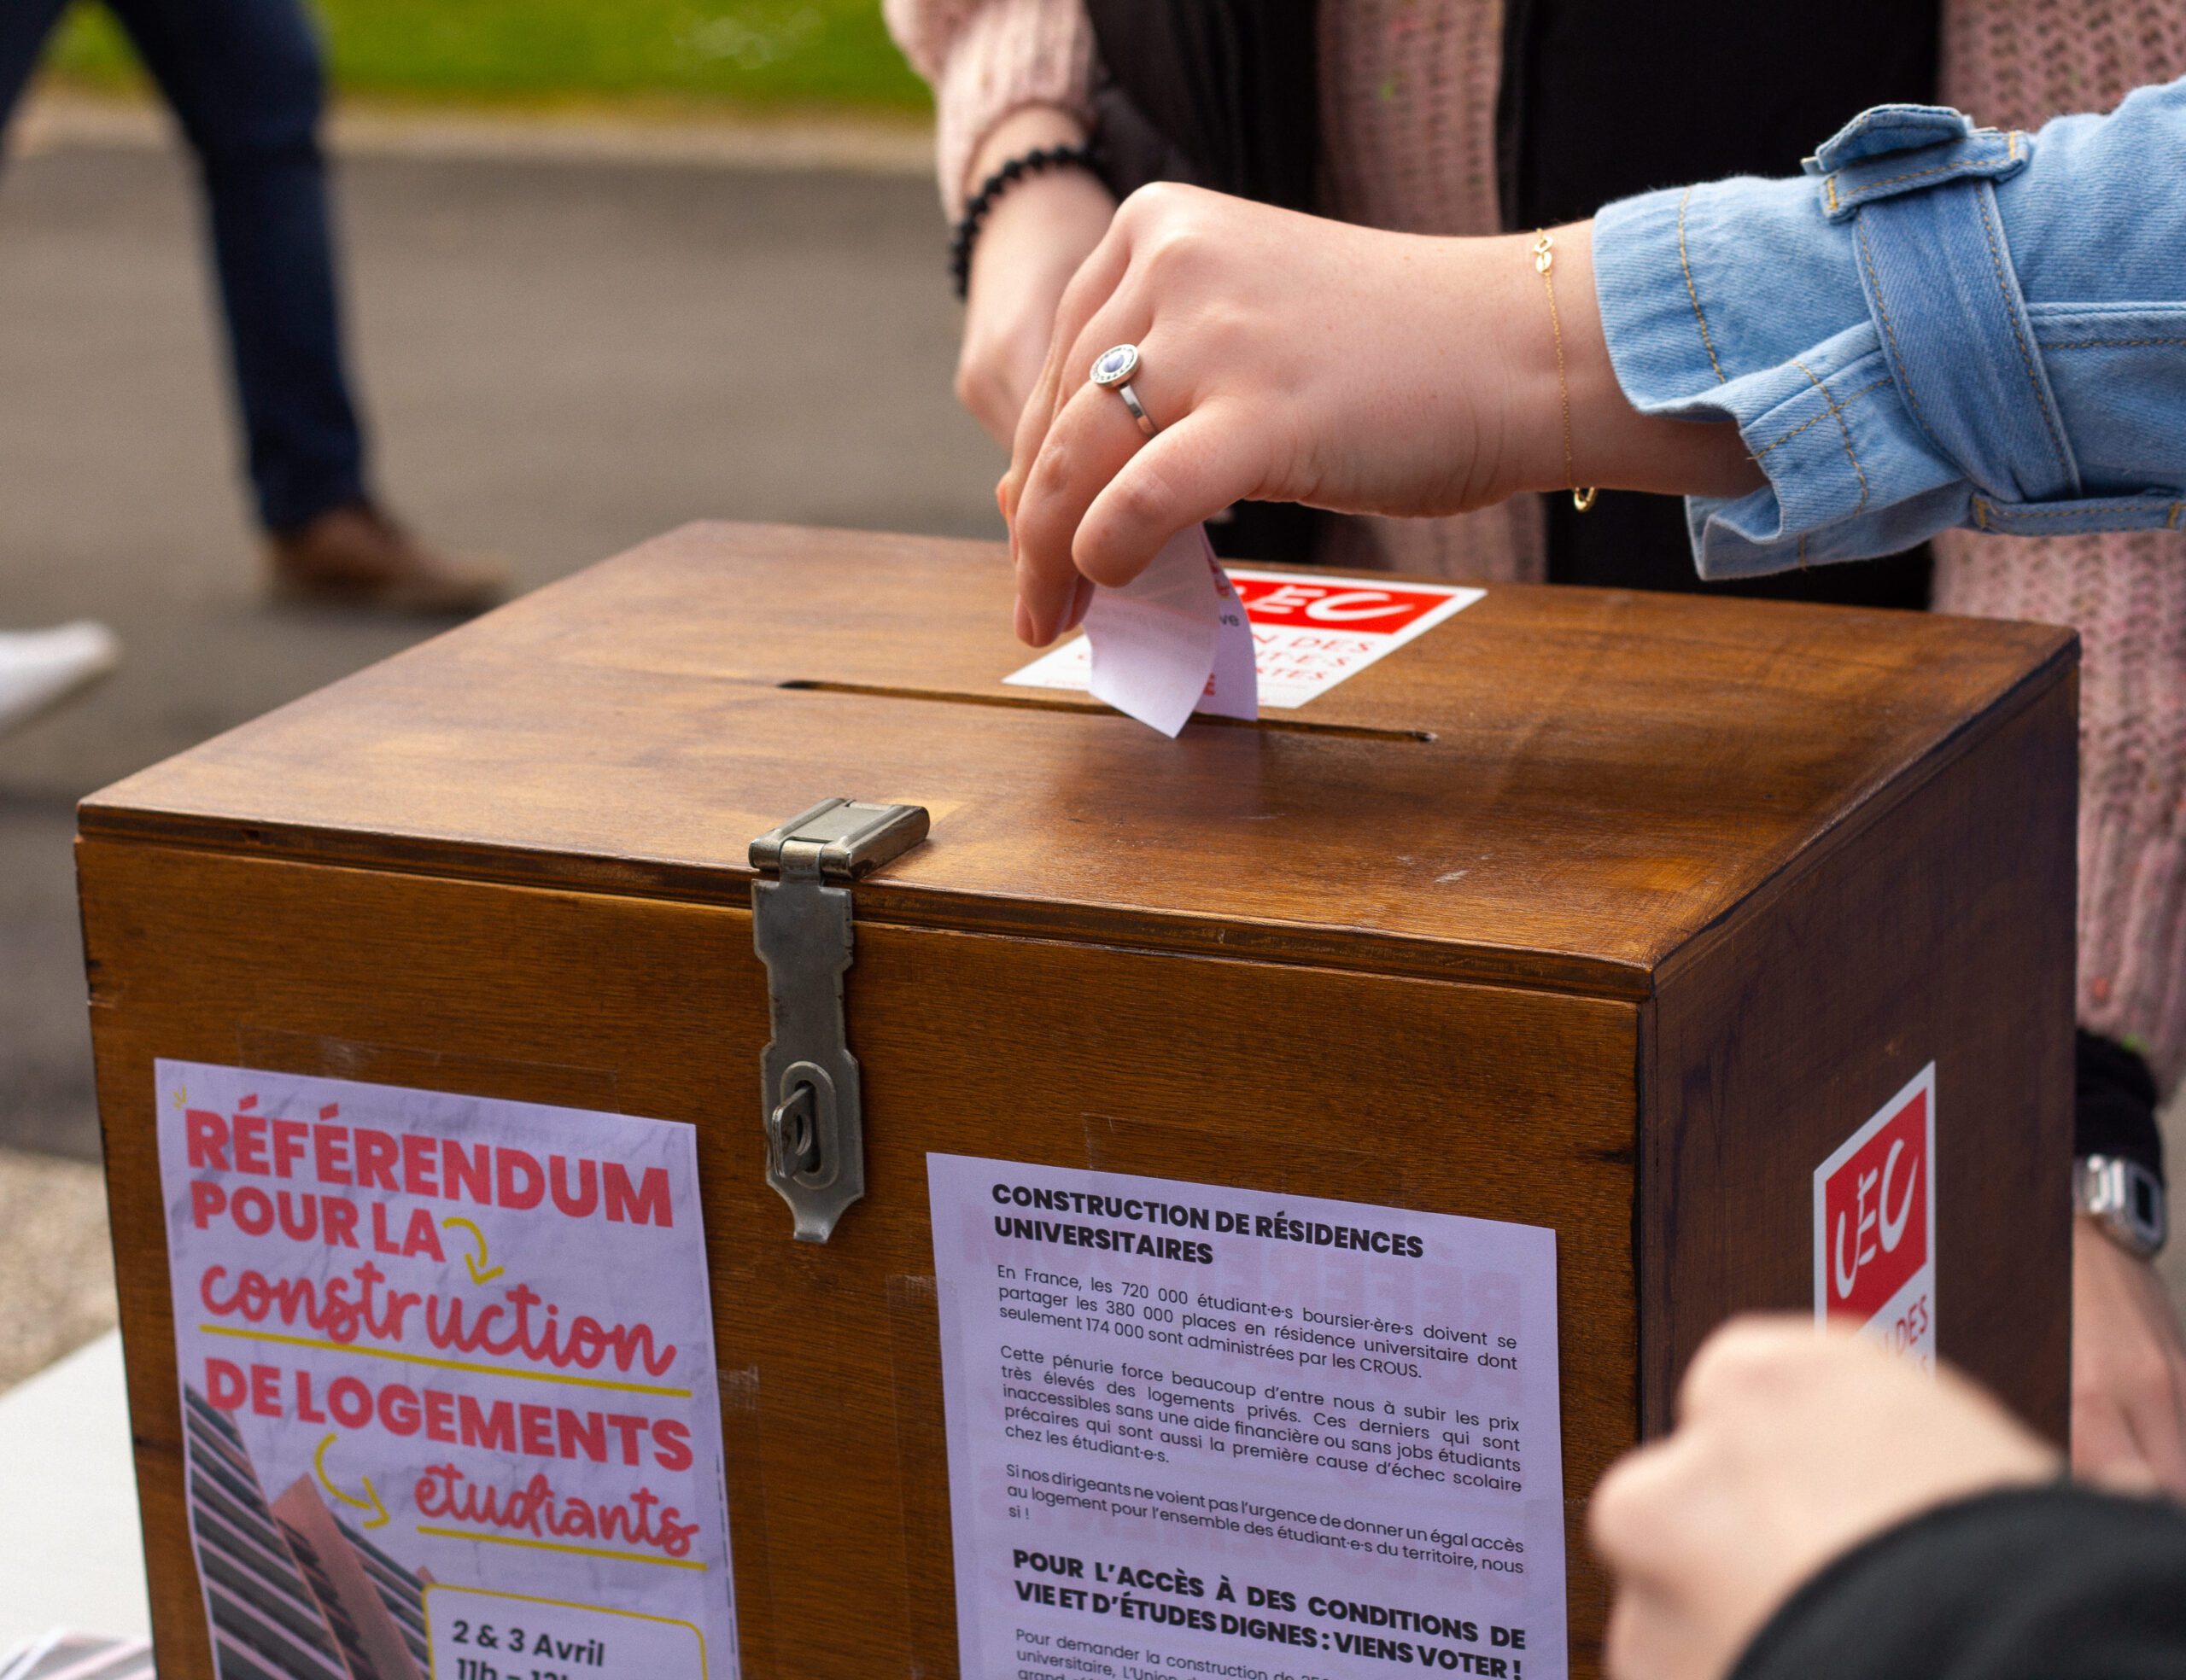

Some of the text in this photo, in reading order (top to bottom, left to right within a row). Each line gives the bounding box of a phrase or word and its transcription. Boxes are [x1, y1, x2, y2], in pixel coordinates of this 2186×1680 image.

[185, 1094, 673, 1228] RÉFÉRENDUM
[190, 1180, 446, 1263] POUR LA
[991, 1183, 1424, 1258] CONSTRUCTION DE RÉSIDENCES
[994, 1215, 1213, 1265] UNIVERSITAIRES
[200, 1260, 676, 1377] construction
[997, 1264, 1016, 1280] En
[1025, 1268, 1082, 1292] France,
[1090, 1276, 1113, 1294] les
[1121, 1281, 1149, 1299] 720
[1158, 1287, 1189, 1305] 000
[1423, 1324, 1488, 1346] doivent
[1497, 1336, 1517, 1350] se
[998, 1286, 1517, 1371] partager les 380 000 places en résidence universitaire dont
[999, 1306, 1422, 1379] seulement 174 000 sont administrées par les CROUS.
[205, 1358, 693, 1472] DE LOGEMENTS
[1000, 1345, 1520, 1432] Cette pénurie force beaucoup d’entre nous à subir les prix
[1001, 1365, 1521, 1452] très élevés des logements privés. Ces derniers qui sont
[1002, 1383, 1521, 1473] inaccessibles sans une aide financière ou sans jobs étudiants
[1004, 1406, 1523, 1493] précaires qui sont aussi la première cause d’échec scolaire
[1005, 1424, 1042, 1443] chez
[1046, 1430, 1068, 1447] les
[1006, 1463, 1524, 1554] Si nos dirigeants ne voient pas l’urgence de donner un égal accès
[1007, 1485, 1028, 1499] au
[1032, 1486, 1108, 1512] logement
[1111, 1502, 1149, 1518] pour
[1152, 1506, 1241, 1532] l’ensemble
[1243, 1521, 1274, 1537] des
[1376, 1541, 1399, 1557] du
[1402, 1545, 1478, 1571] territoire,
[1482, 1558, 1524, 1574] nous
[1008, 1505, 1021, 1519] si
[452, 1619, 605, 1667] 2 & 3 Avril
[1012, 1549, 1527, 1651] POUR L’ACCÈS À DES CONDITIONS DE
[1014, 1579, 1056, 1607] VIE
[1059, 1587, 1089, 1612] ET
[1091, 1590, 1218, 1632] D’ÉTUDES
[1220, 1613, 1318, 1648] DIGNES
[1332, 1630, 1414, 1664] VIENS
[1416, 1644, 1508, 1680] VOTER
[1015, 1628, 1050, 1646] Pour
[1056, 1636, 1140, 1661] demander
[1146, 1649, 1160, 1665] la
[1166, 1656, 1268, 1680] construction
[1016, 1650, 1116, 1678] universitaire,
